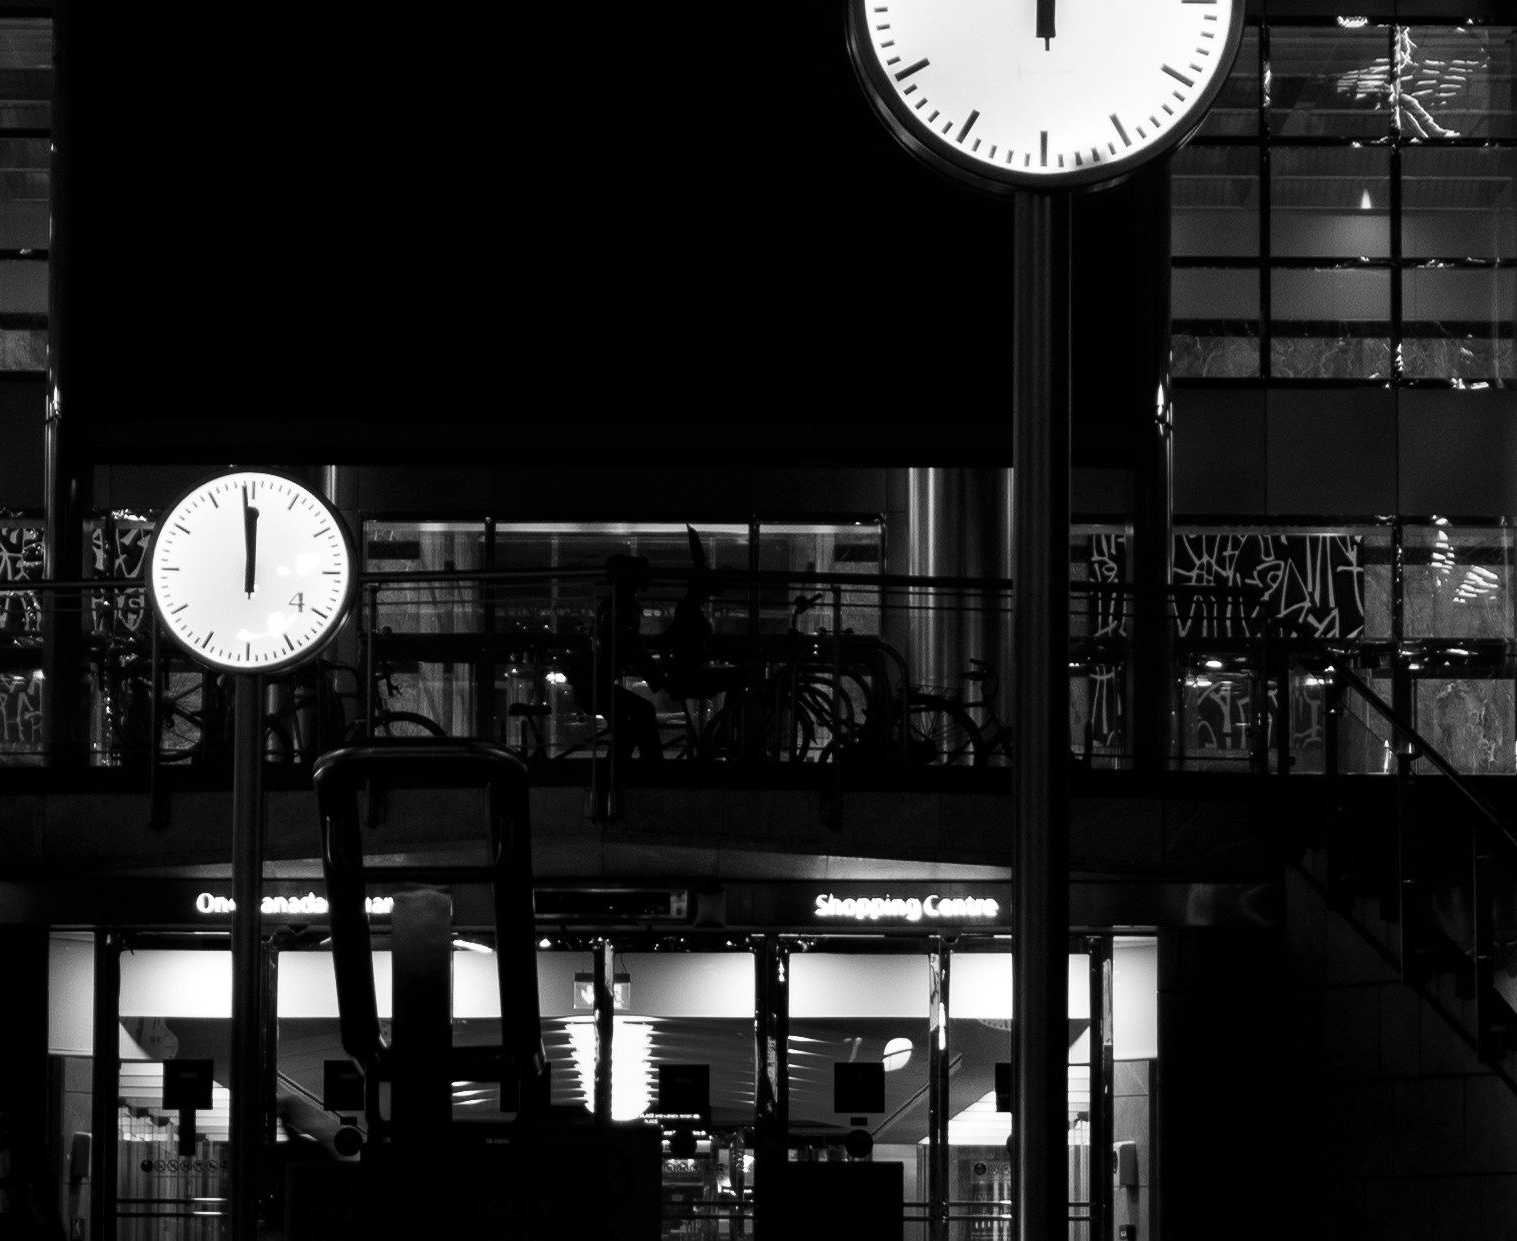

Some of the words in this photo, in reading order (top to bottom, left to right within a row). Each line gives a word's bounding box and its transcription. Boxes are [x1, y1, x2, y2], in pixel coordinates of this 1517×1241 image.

[288, 592, 305, 613] 4
[260, 891, 329, 914] anada
[814, 893, 922, 922] Shopping
[923, 894, 999, 917] Centre
